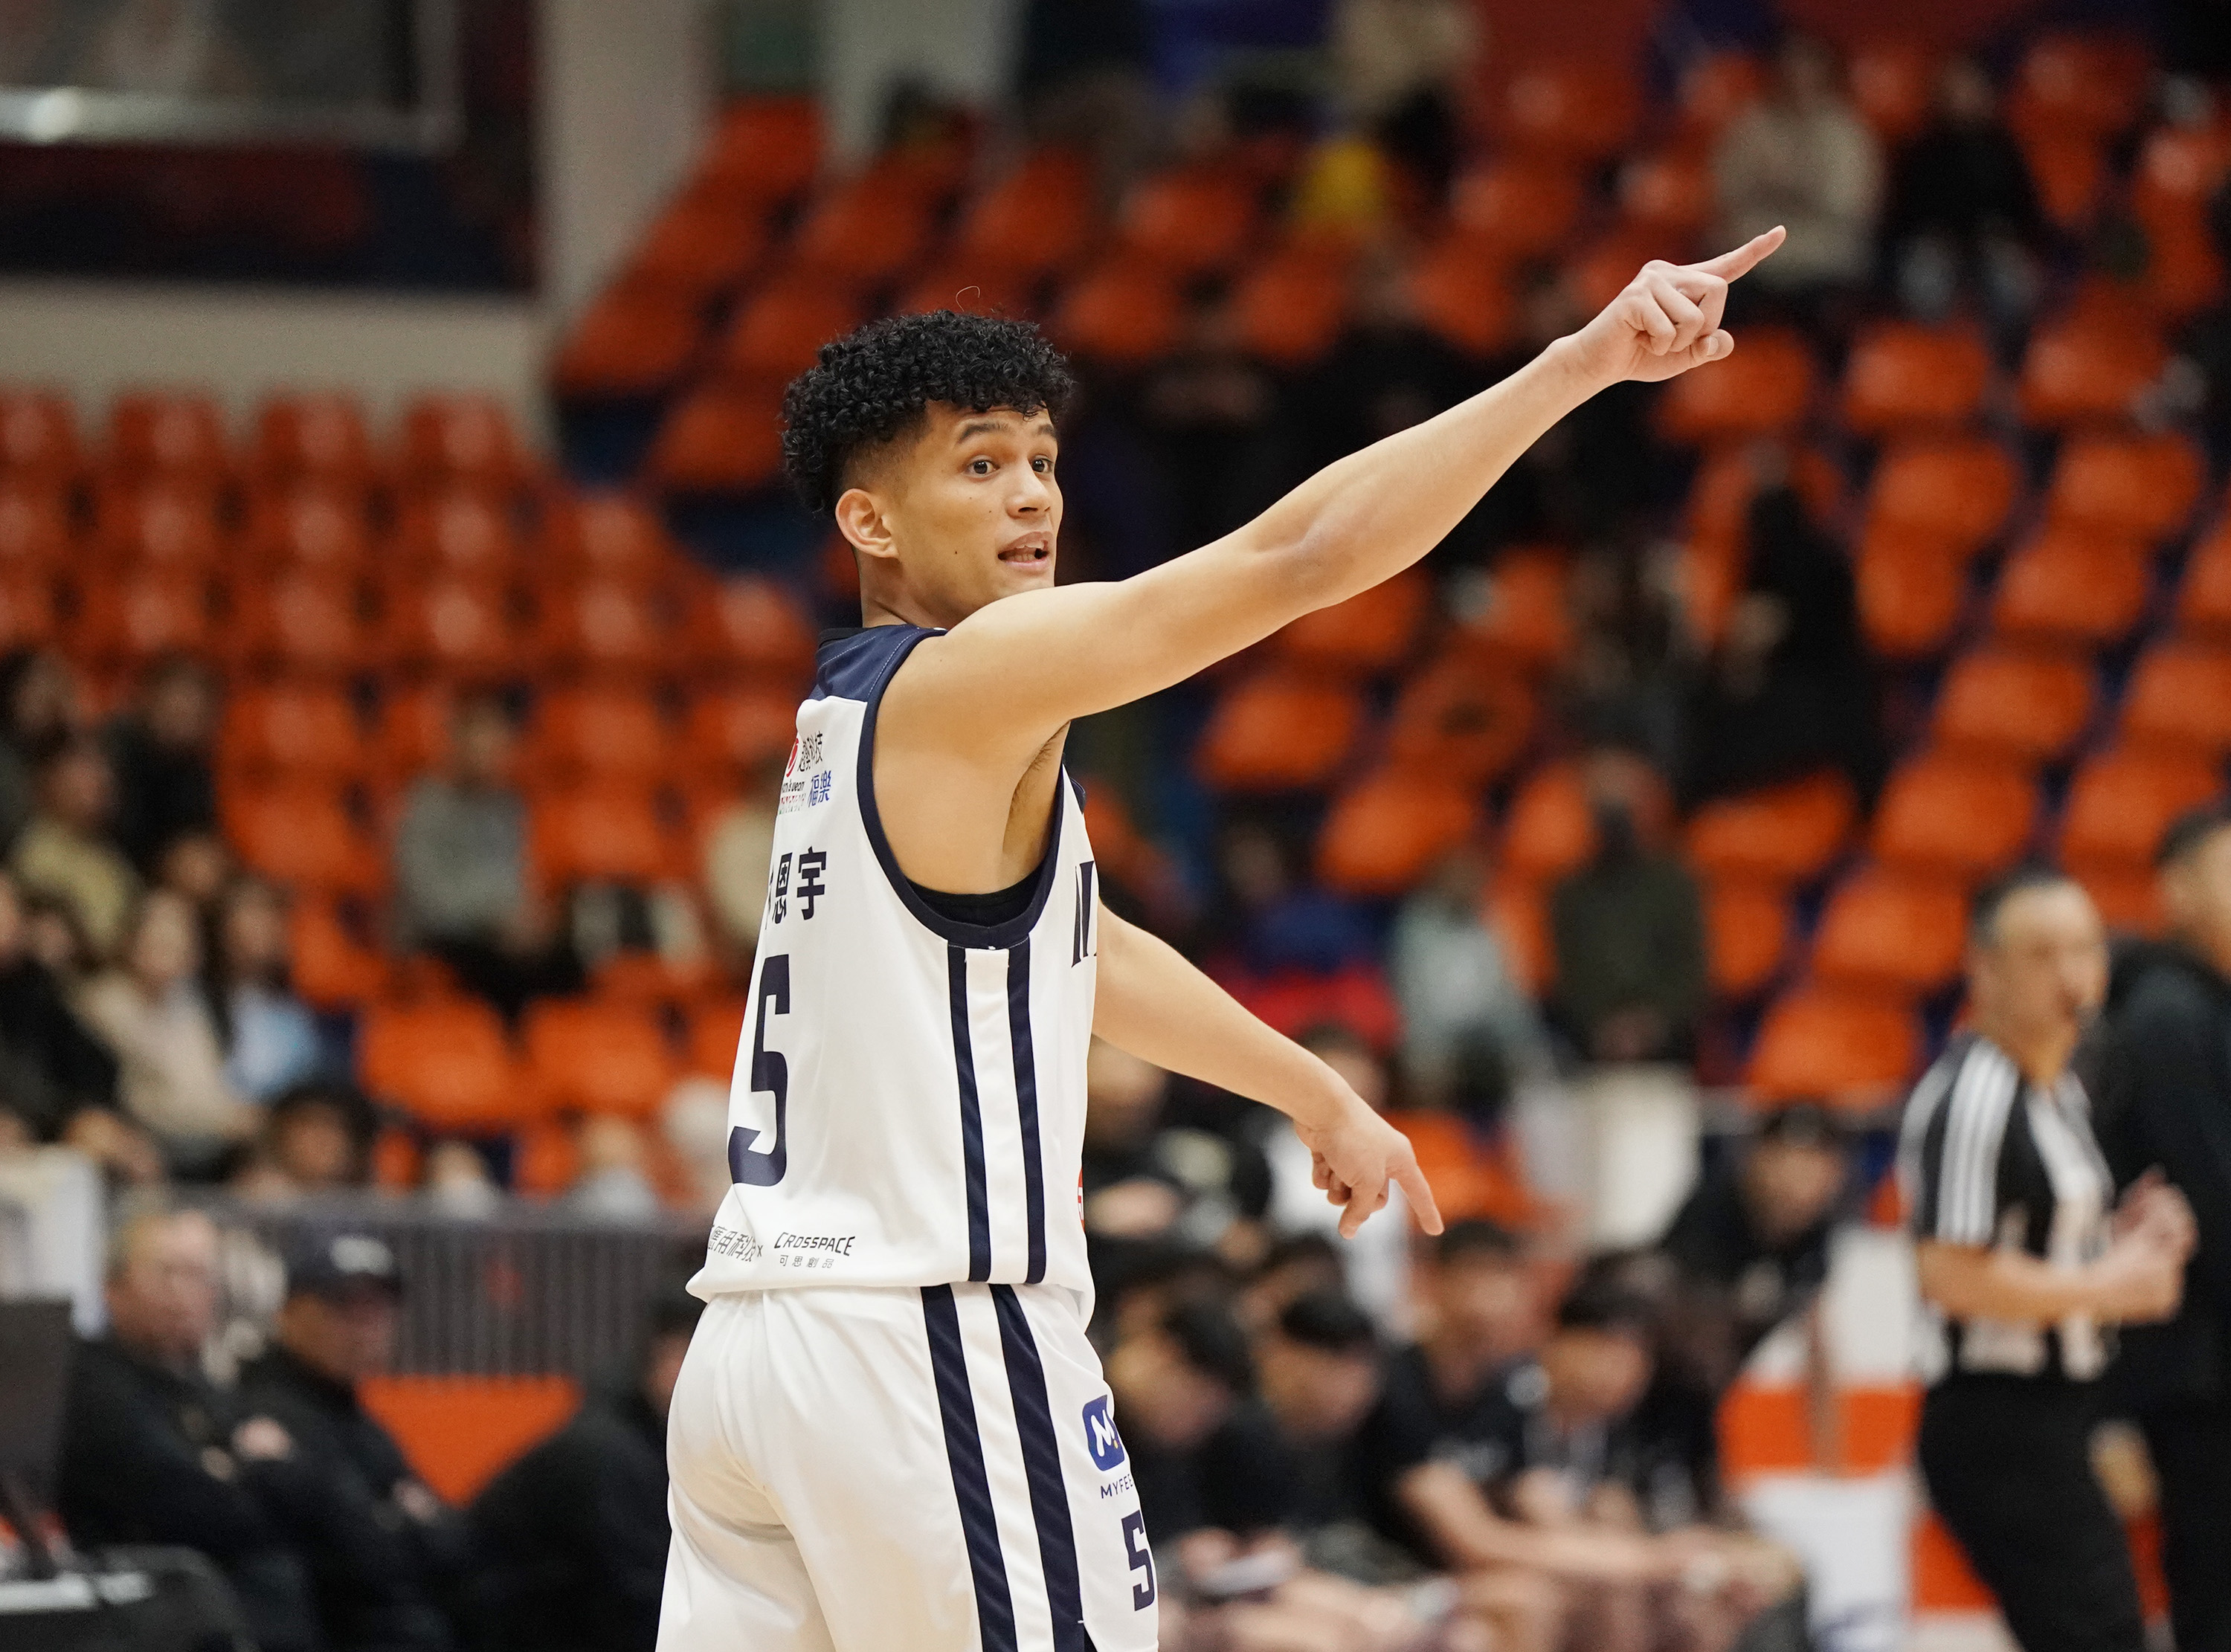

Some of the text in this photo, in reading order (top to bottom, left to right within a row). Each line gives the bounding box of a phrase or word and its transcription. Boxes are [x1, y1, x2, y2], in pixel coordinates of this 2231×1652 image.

[808, 770, 831, 807] 福樂
[764, 846, 827, 930] 恩宇
[728, 954, 790, 1187] 5
[773, 1231, 856, 1256] CROSSPACE
[779, 1254, 834, 1269] 可思創品
[1100, 1473, 1136, 1500] MYFEE
[1121, 1509, 1156, 1611] 5
